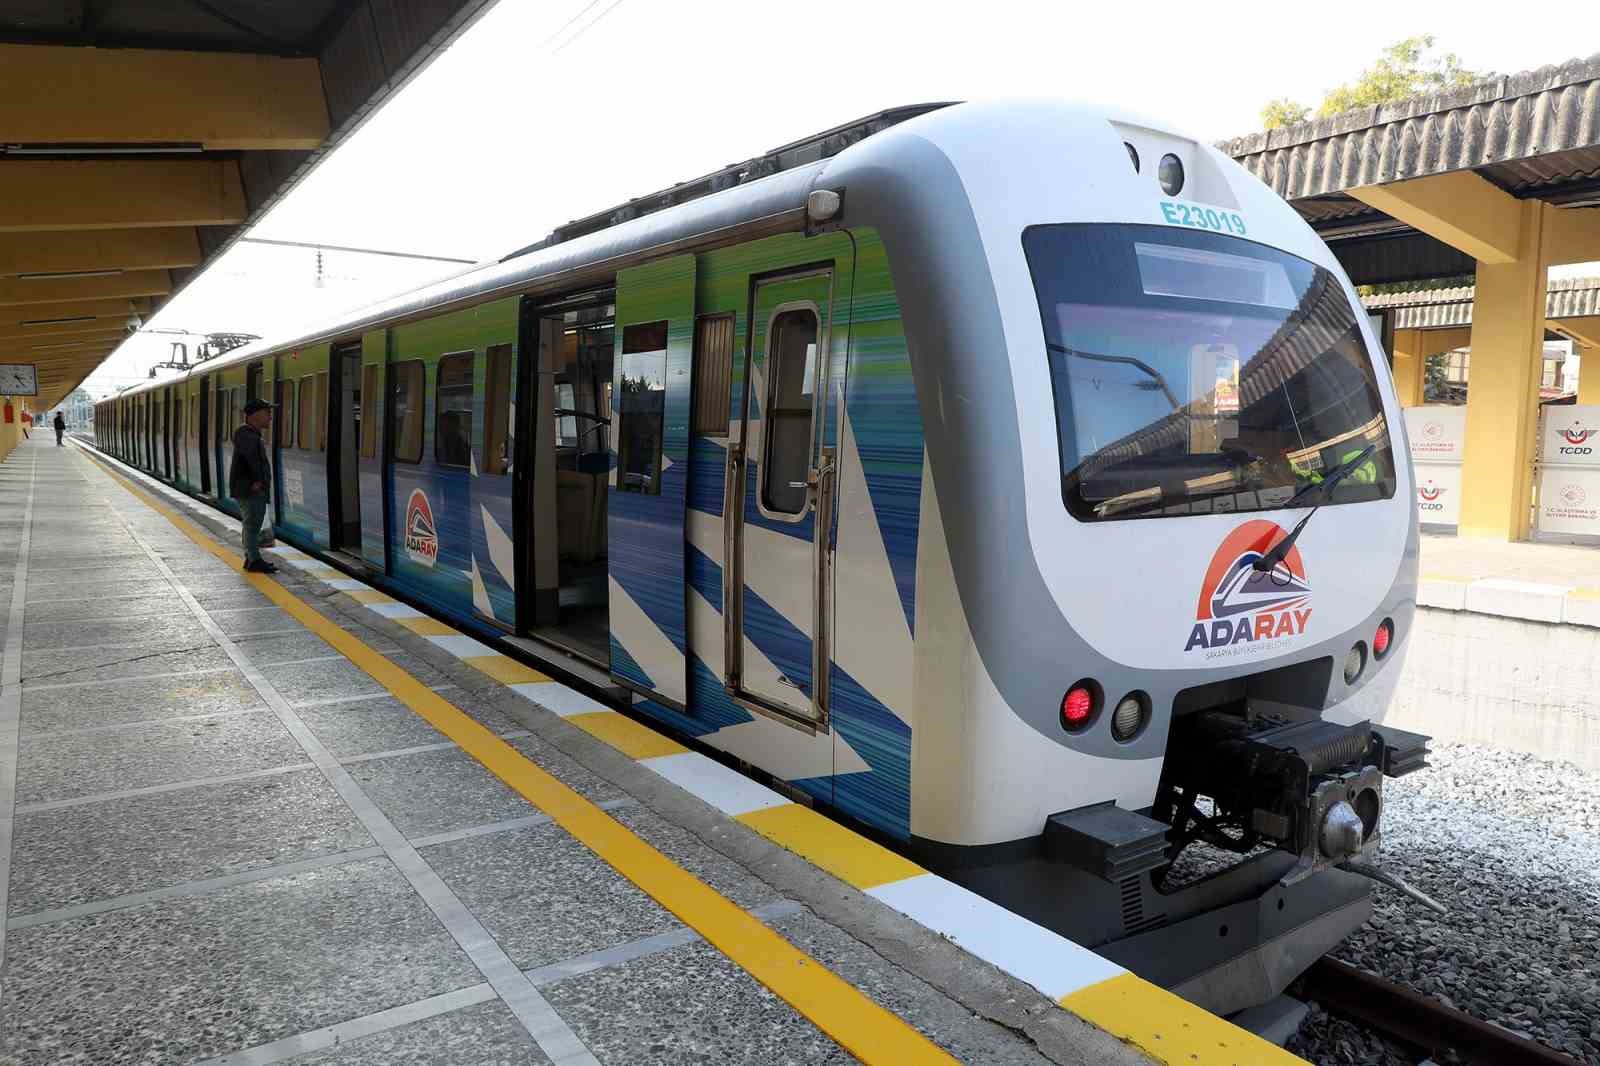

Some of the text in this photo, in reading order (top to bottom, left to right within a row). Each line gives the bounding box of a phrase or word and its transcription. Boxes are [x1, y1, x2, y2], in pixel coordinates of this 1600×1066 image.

[1160, 202, 1246, 235] E23019
[1560, 447, 1592, 455] TCDD
[406, 536, 437, 557] ADARAY
[1184, 608, 1312, 651] ADARAY
